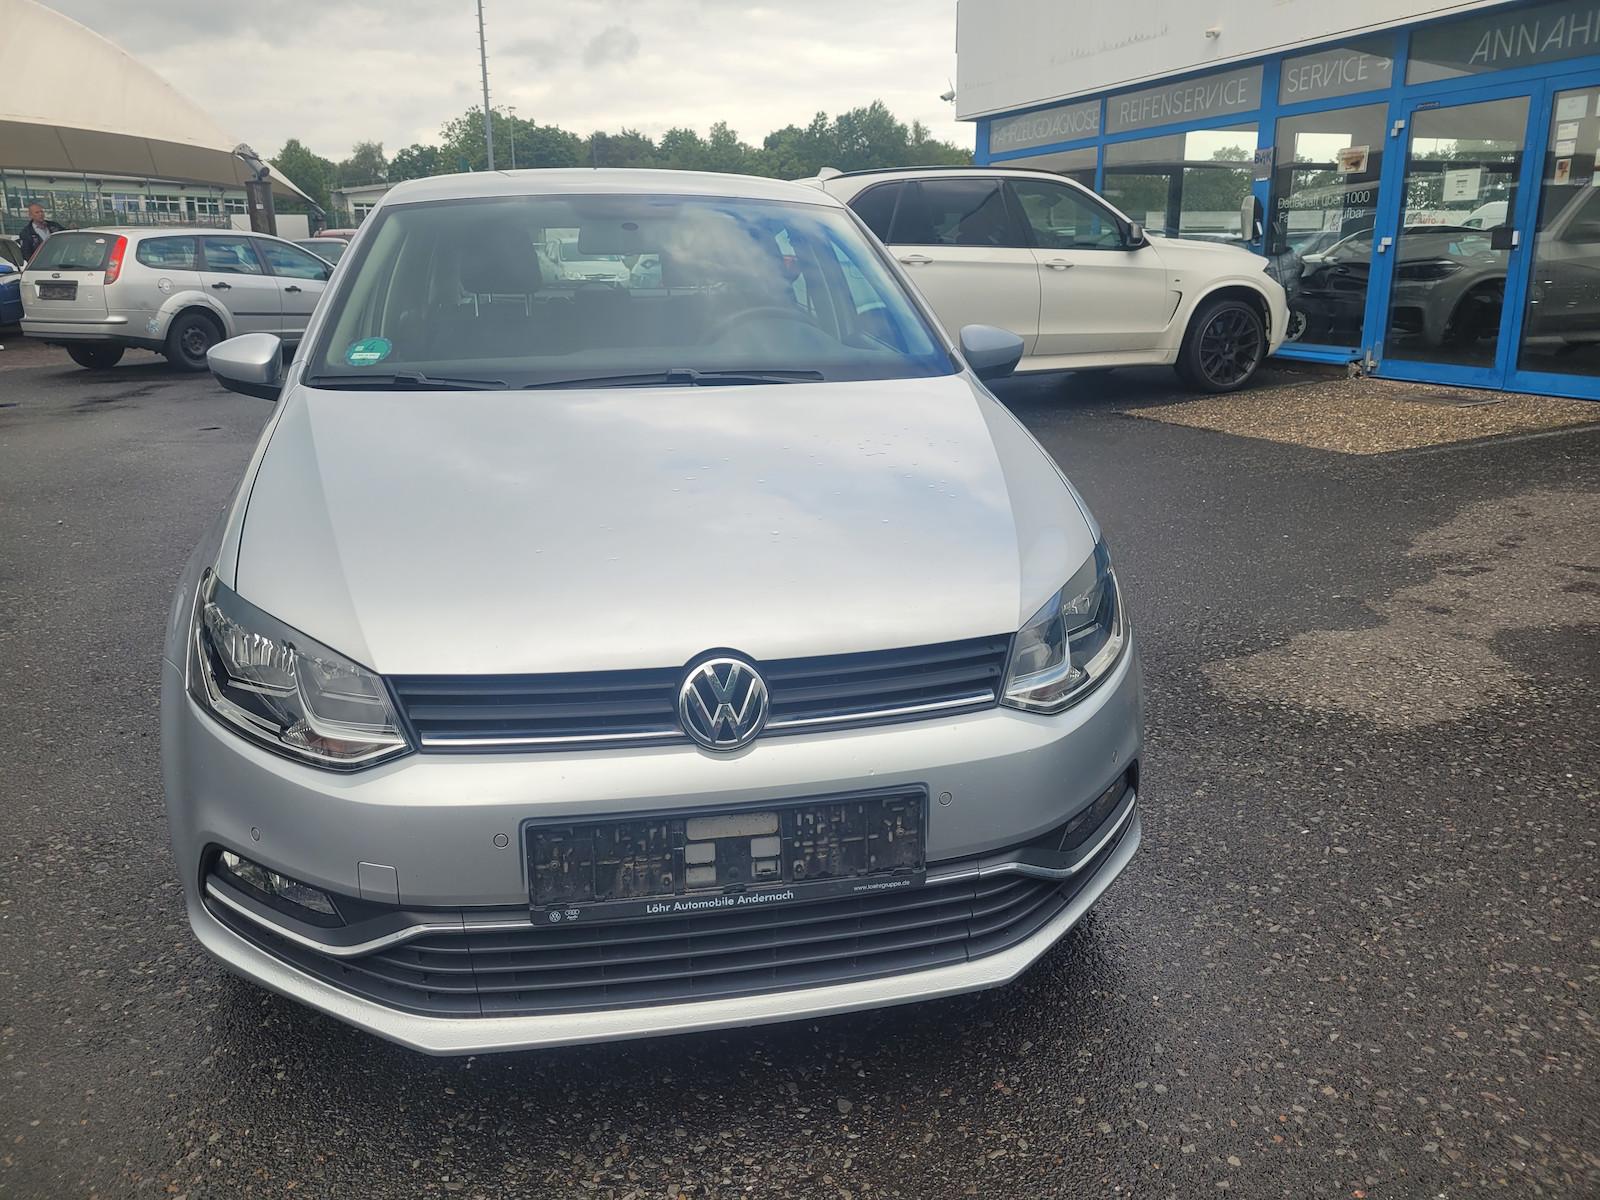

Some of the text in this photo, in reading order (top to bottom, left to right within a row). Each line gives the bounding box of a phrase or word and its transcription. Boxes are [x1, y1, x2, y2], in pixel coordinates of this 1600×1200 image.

[1287, 54, 1369, 93] SERVICE
[1119, 77, 1249, 125] REIFENSERVICE
[1345, 190, 1370, 204] 1000
[646, 890, 794, 914] Löhr Automobile Andernach
